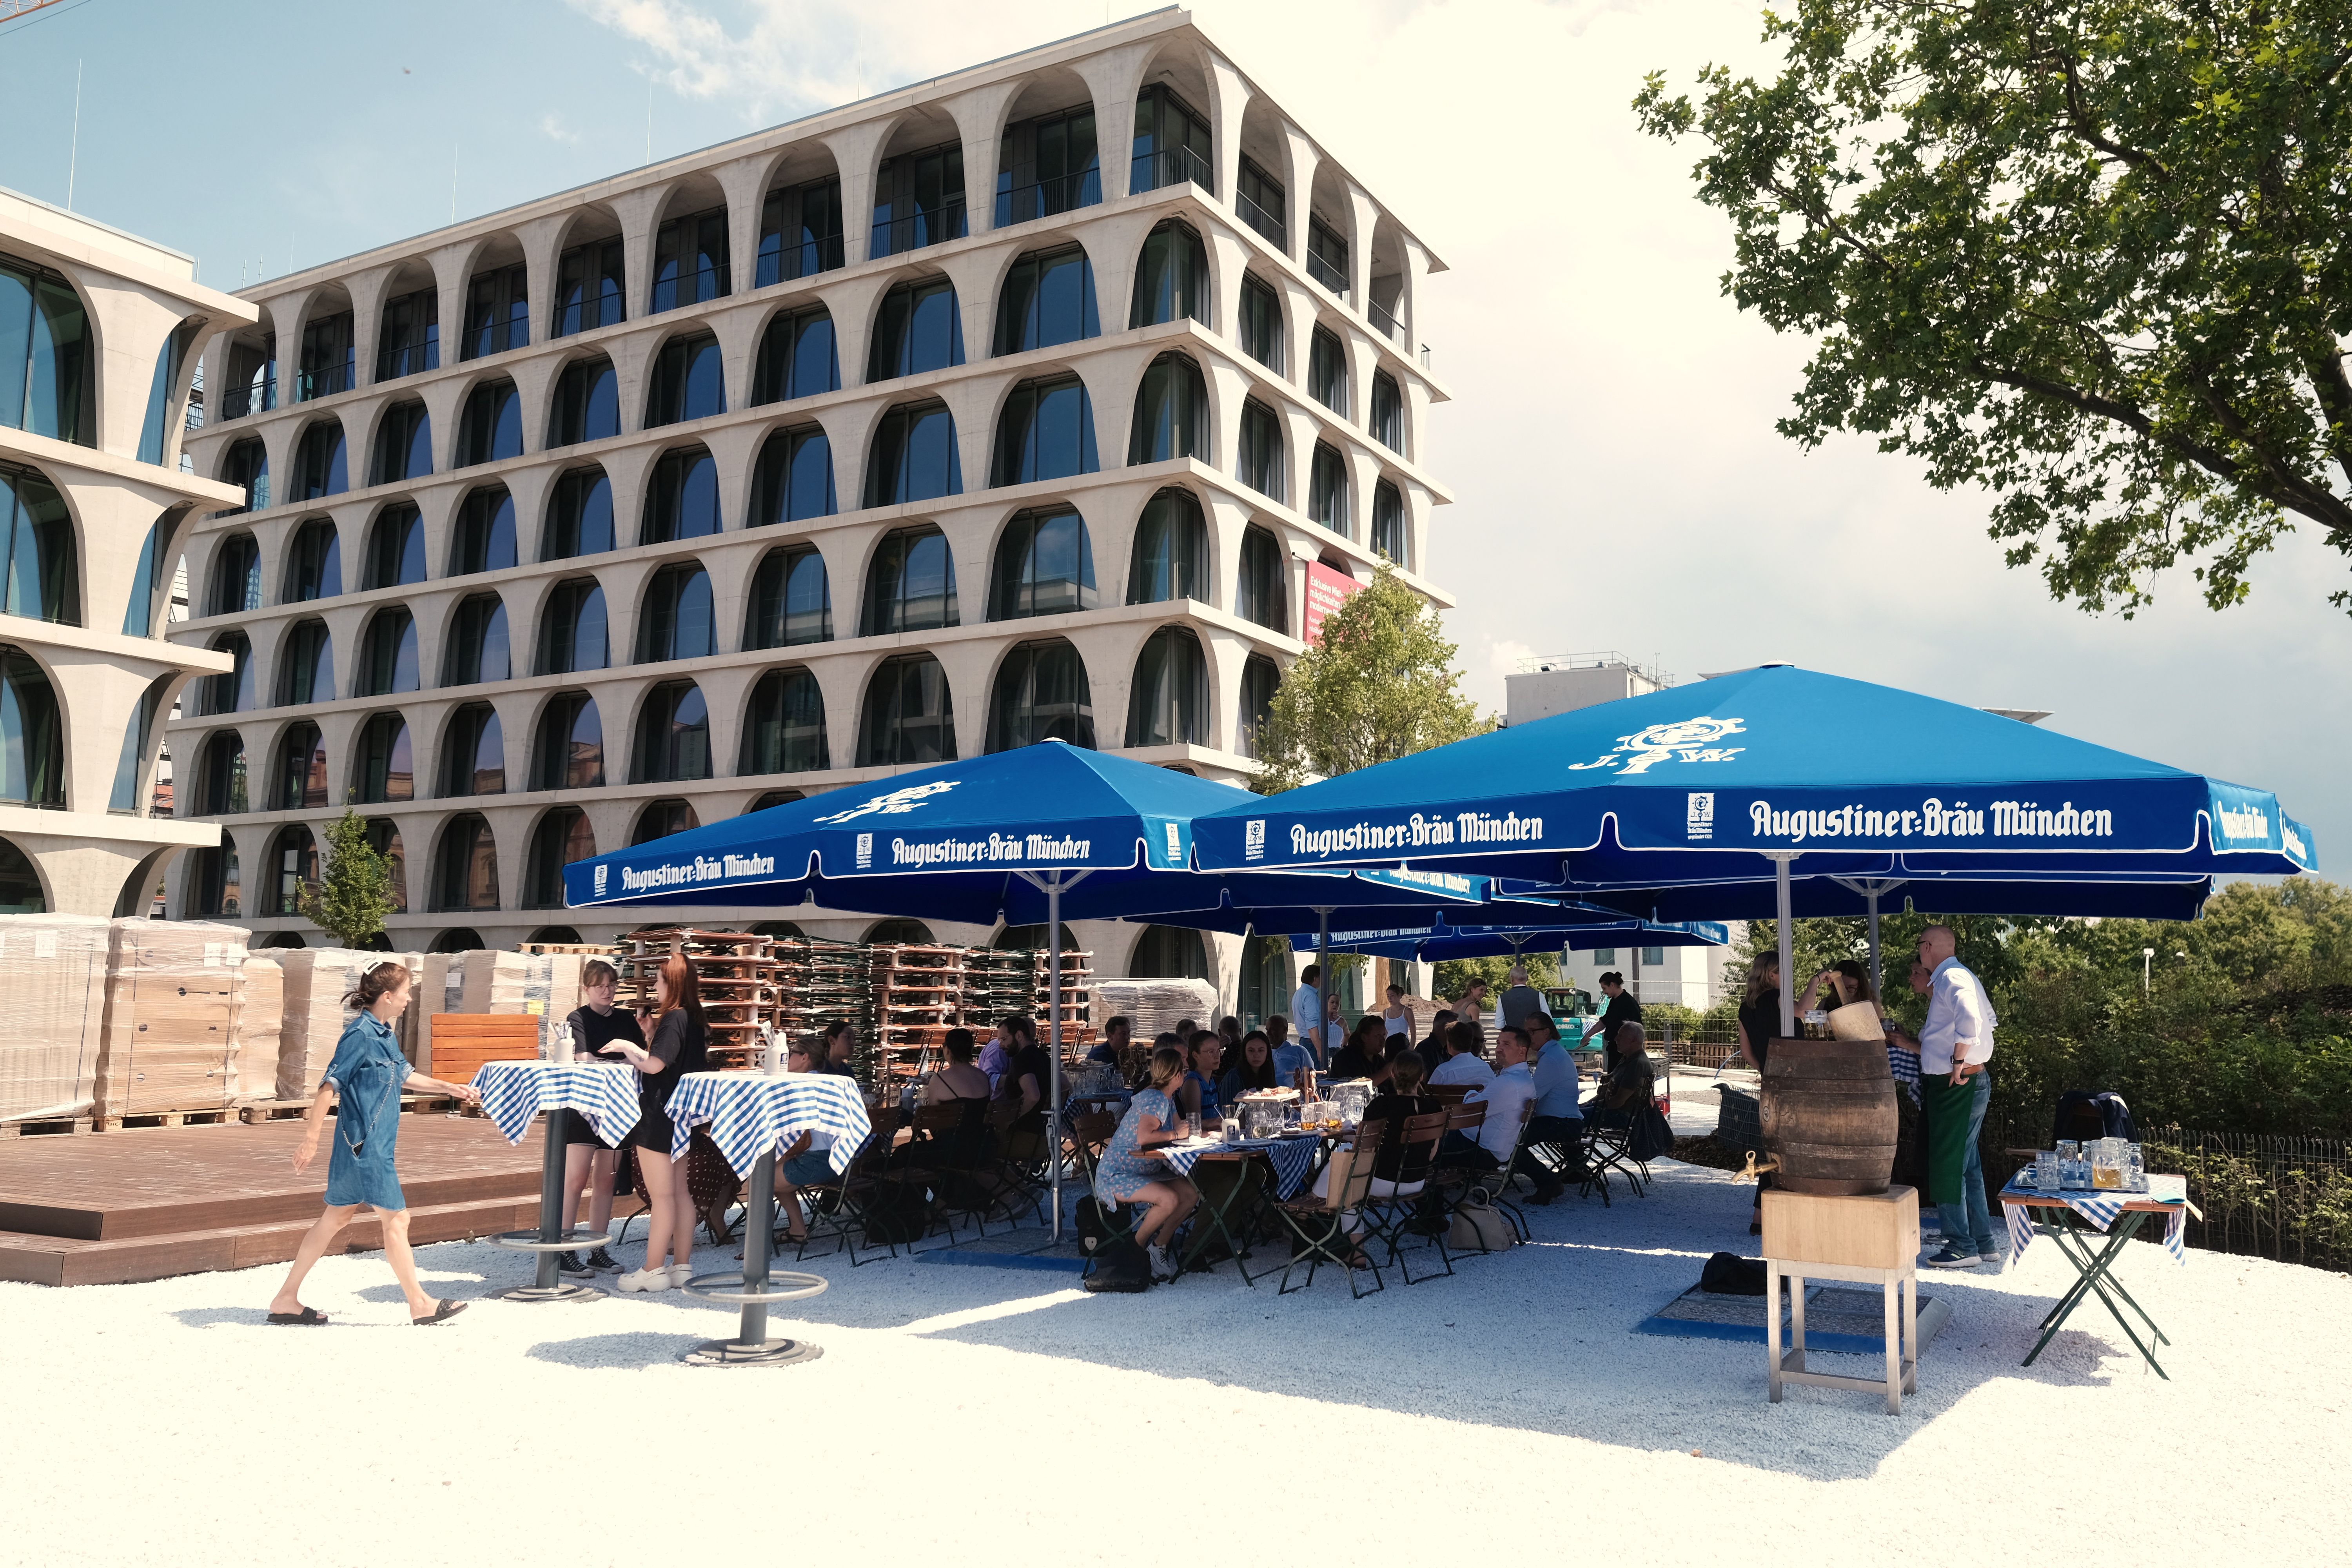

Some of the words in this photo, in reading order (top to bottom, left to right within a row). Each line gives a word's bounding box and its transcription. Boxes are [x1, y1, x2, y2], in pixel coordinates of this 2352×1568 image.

[1310, 575, 1332, 593] Exklusive
[1332, 585, 1343, 598] Miet-
[1310, 589, 1340, 609] möglichkeiten
[1457, 811, 1543, 842] München
[1990, 801, 2113, 837] München
[1026, 834, 1090, 860] München
[723, 853, 774, 878] München
